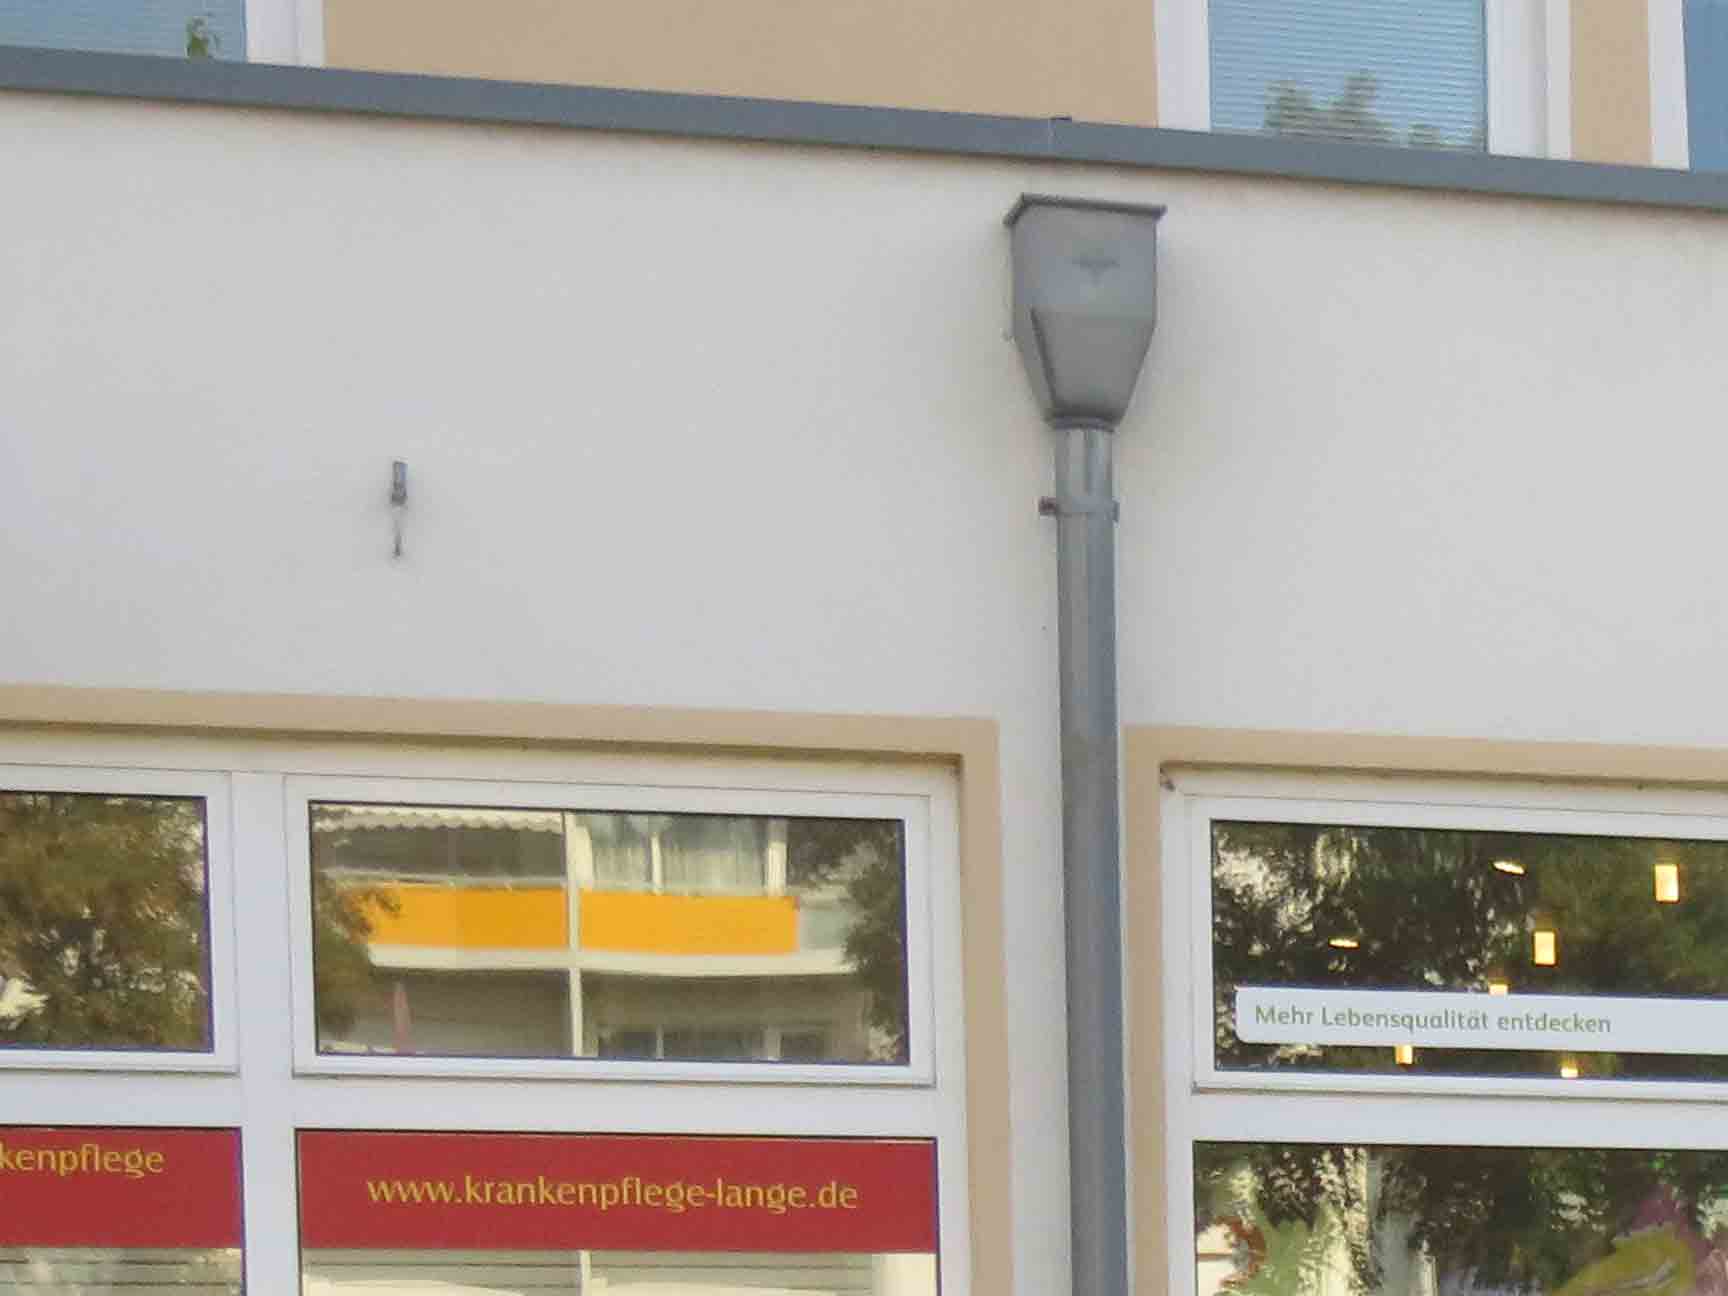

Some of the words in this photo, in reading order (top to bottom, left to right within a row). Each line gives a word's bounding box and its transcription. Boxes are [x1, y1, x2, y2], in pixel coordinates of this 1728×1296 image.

[1254, 1005, 1314, 1027] Mehr
[1321, 1007, 1489, 1035] Lebensqualität
[1497, 1012, 1612, 1034] entdecken
[0, 1142, 165, 1179] kenpflege
[366, 1175, 859, 1215] www.krankenpflege-lange.de
